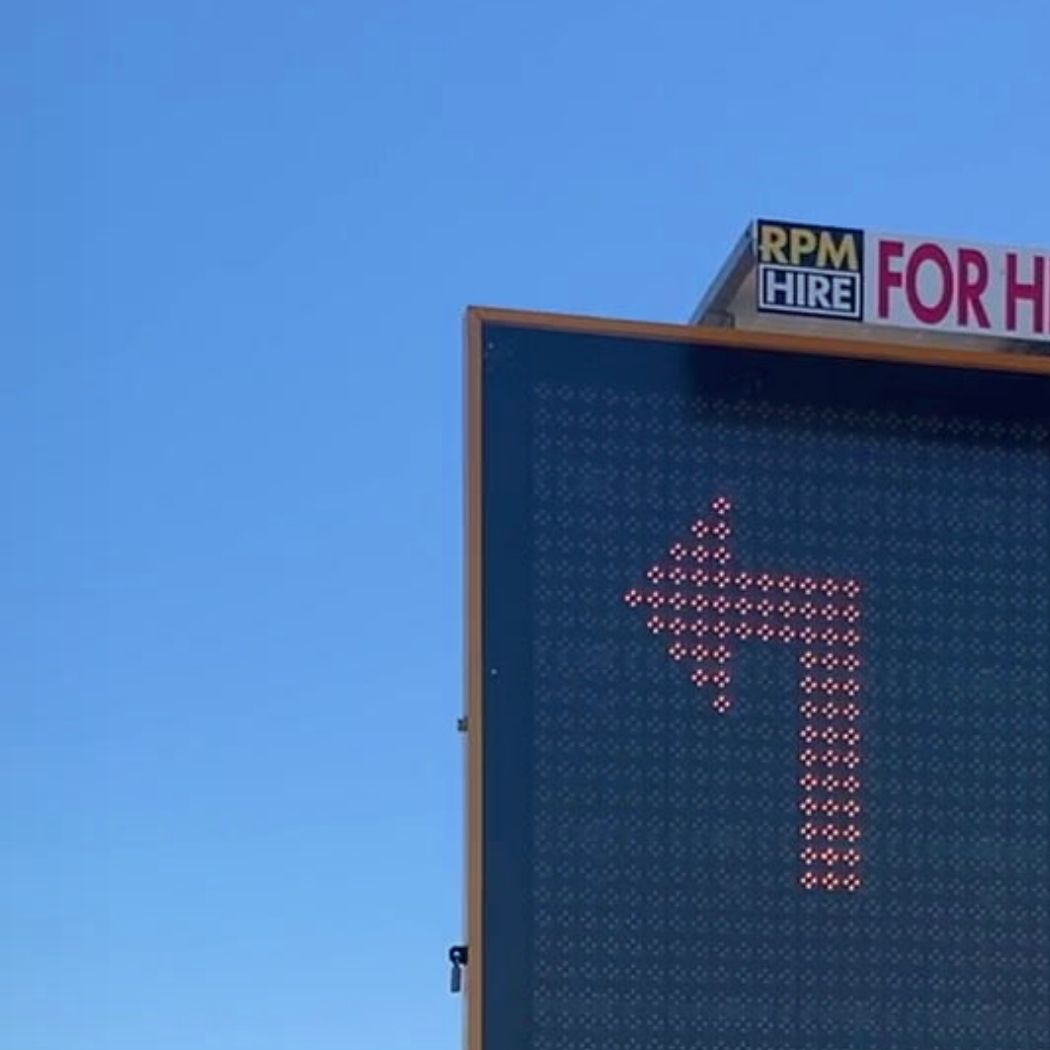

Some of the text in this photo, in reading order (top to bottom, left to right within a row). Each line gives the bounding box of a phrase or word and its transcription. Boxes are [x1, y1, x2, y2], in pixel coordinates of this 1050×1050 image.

[760, 225, 859, 270] RPM
[766, 270, 852, 309] HIRE
[878, 240, 991, 328] FOR
